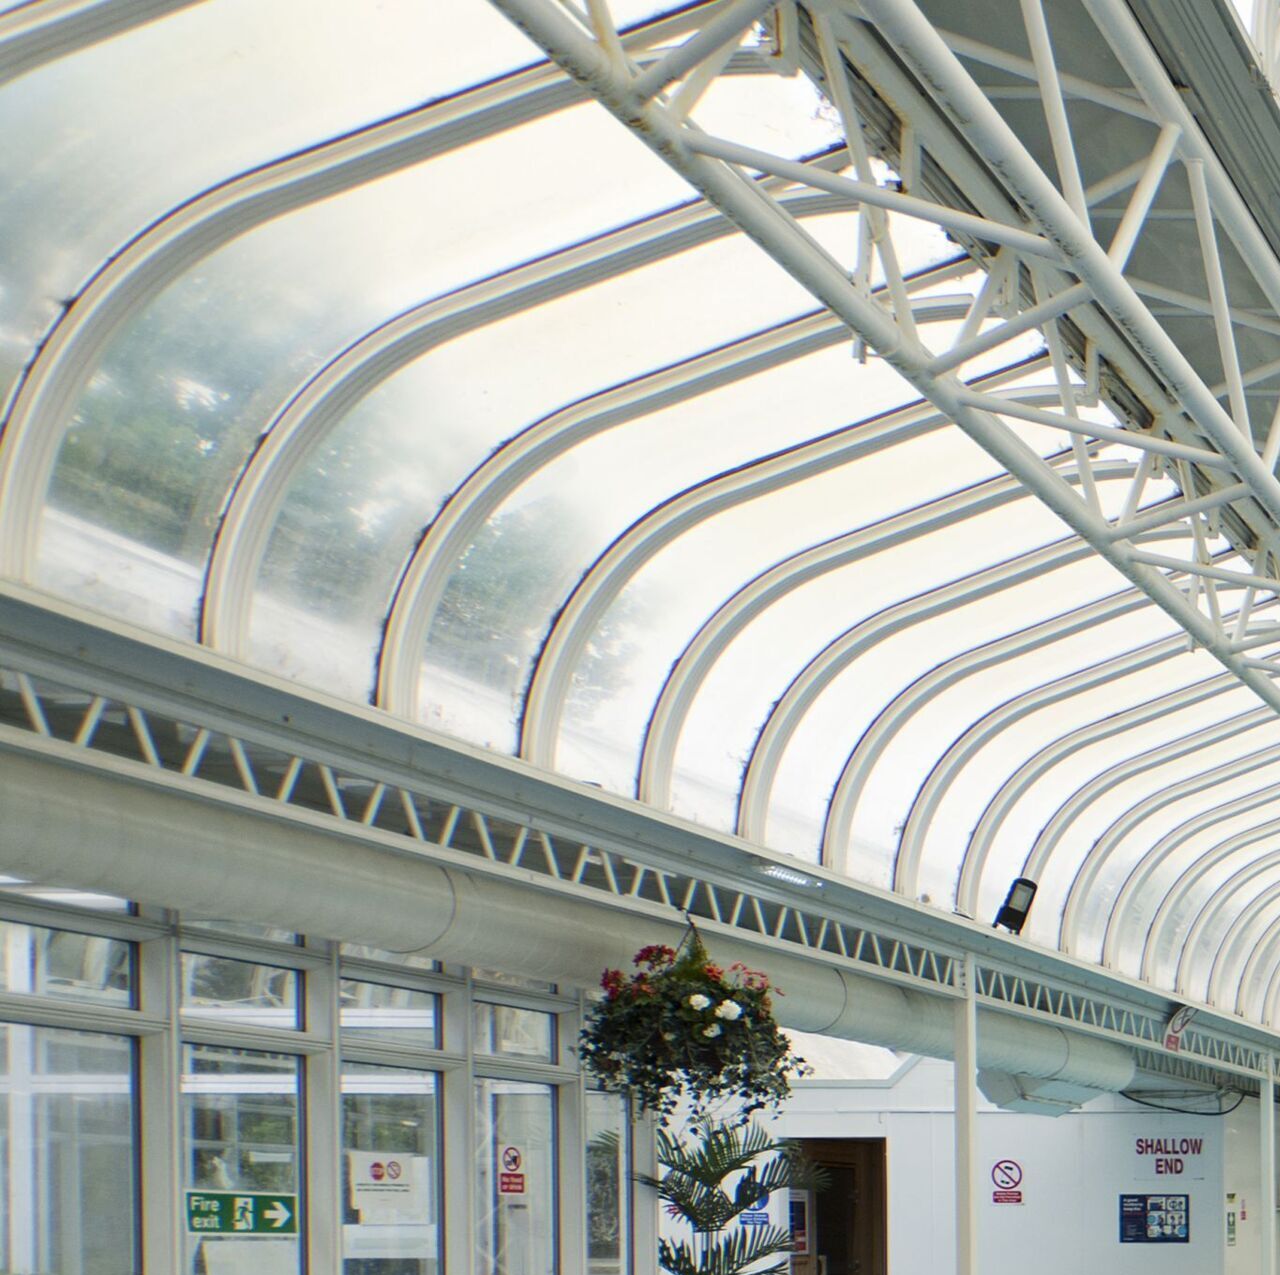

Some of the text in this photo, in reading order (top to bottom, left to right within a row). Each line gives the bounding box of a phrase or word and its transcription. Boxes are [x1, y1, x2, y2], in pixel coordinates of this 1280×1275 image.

[1135, 1138, 1203, 1155] SHALLOW
[1155, 1158, 1184, 1175] END
[191, 1196, 220, 1212] Fire
[192, 1214, 220, 1229] exit
